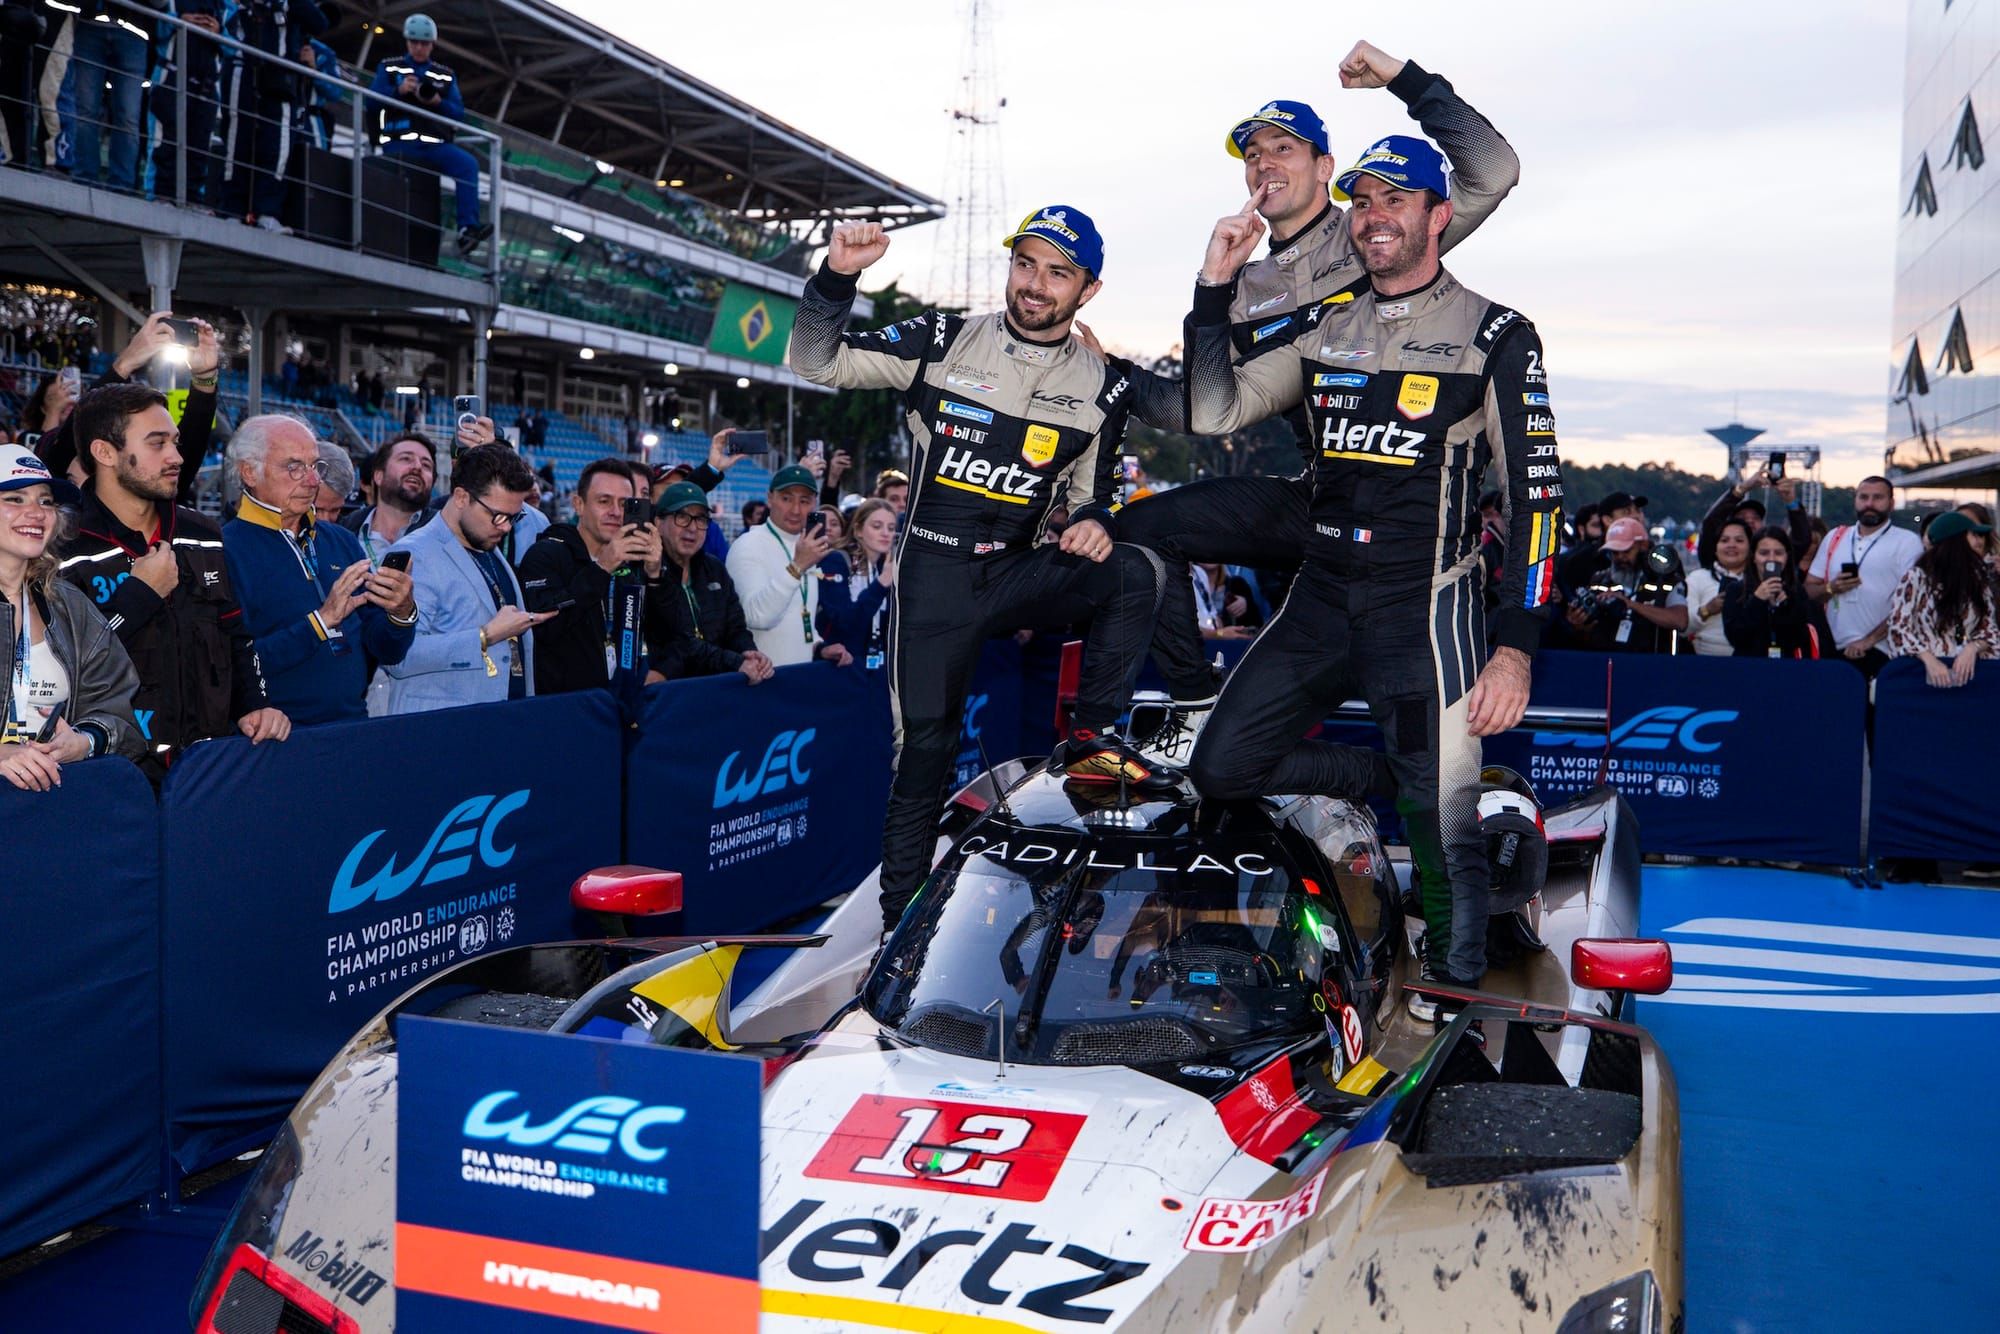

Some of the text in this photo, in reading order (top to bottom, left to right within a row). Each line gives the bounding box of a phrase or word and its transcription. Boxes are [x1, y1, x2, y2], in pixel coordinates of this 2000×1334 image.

[1483, 311, 1519, 341] HRX
[1402, 341, 1462, 356] WEC
[950, 368, 986, 381] RACING
[951, 362, 999, 379] CADILLAC
[1032, 390, 1084, 410] WEC
[1105, 377, 1129, 404] HRX
[935, 420, 971, 441] Mobil
[1323, 417, 1427, 458] Hertz
[938, 446, 1043, 497] Hertz
[911, 524, 959, 546] W.STEVENS
[625, 594, 633, 629] UNIQUE
[623, 633, 632, 666] DESIGN
[713, 728, 816, 809] WEC
[1531, 756, 1721, 775] FIA WORD ENDURANCE
[710, 797, 809, 839] FIA WORLD ENDURANCE
[328, 789, 531, 914] WEC
[709, 822, 776, 856] CHAMPIONSHIP
[709, 841, 775, 871] A PARTNERSHIP
[959, 836, 1274, 876] CADILLAC
[327, 883, 517, 957] FIA WORLD ENDURANCE
[327, 923, 457, 980] CHAMPIONSHIP
[328, 949, 456, 1003] A PARTNERSHIP
[626, 995, 659, 1030] 12
[462, 1090, 687, 1163] WEC
[851, 1106, 1036, 1188] 12
[461, 1148, 669, 1195] FIA WORLD ENDURANCE
[461, 1165, 595, 1198] CHAMPIONSHIP
[1199, 1194, 1313, 1247] CAR
[284, 1230, 365, 1291] Mobil
[483, 1260, 661, 1311] HYPERCAR
